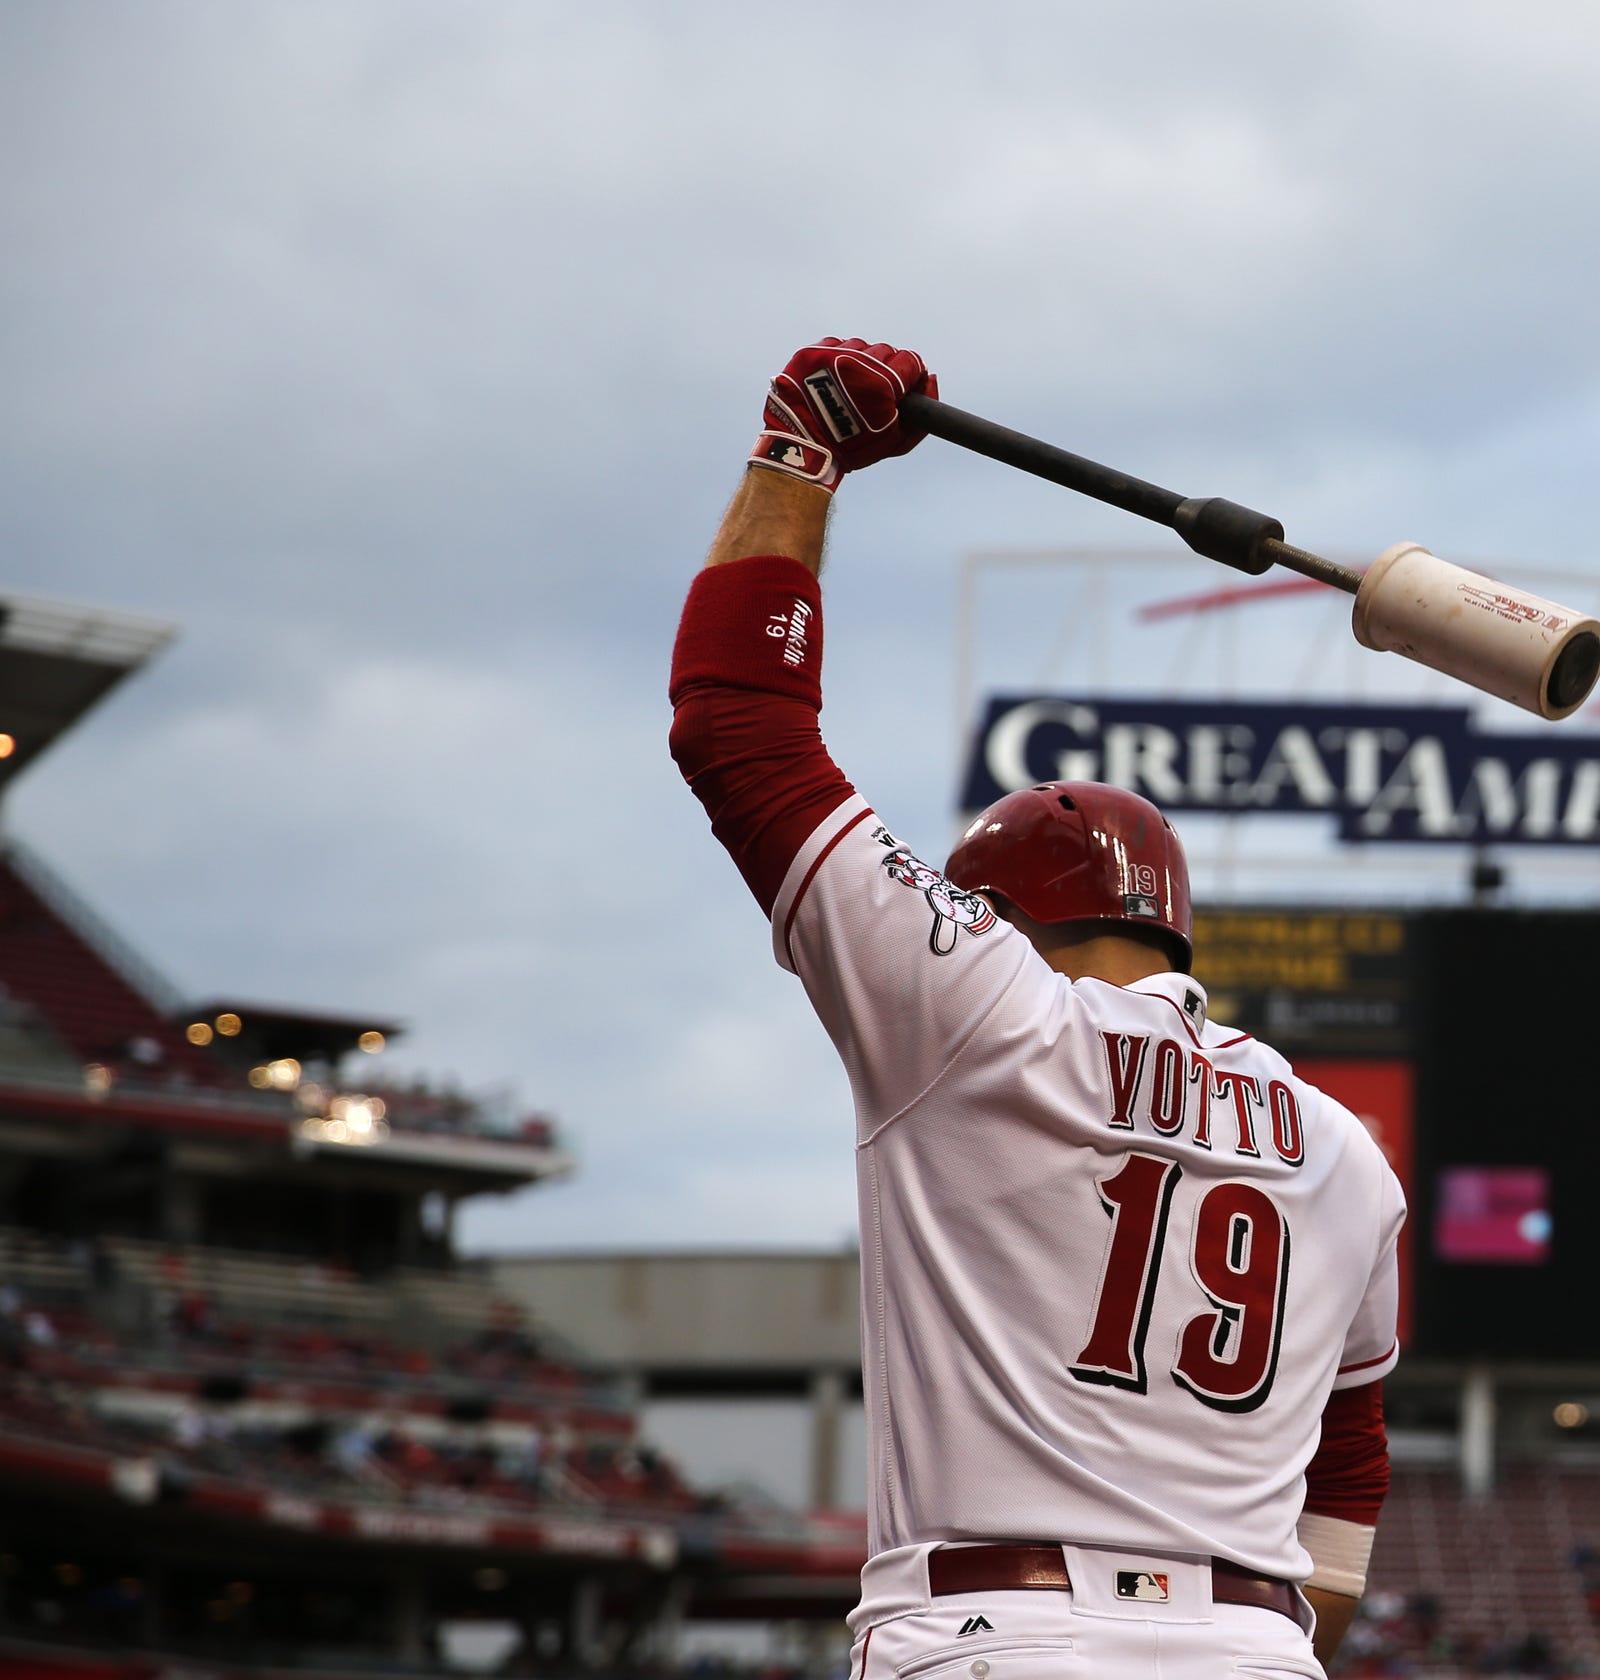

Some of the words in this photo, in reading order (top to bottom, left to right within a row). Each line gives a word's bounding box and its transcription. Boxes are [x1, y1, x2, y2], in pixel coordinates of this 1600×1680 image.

[765, 613, 788, 638] 19
[985, 699, 1410, 806] GREAT
[1127, 863, 1157, 897] 19
[1099, 1031, 1304, 1167] VOTTO
[1067, 1151, 1291, 1414] 19
